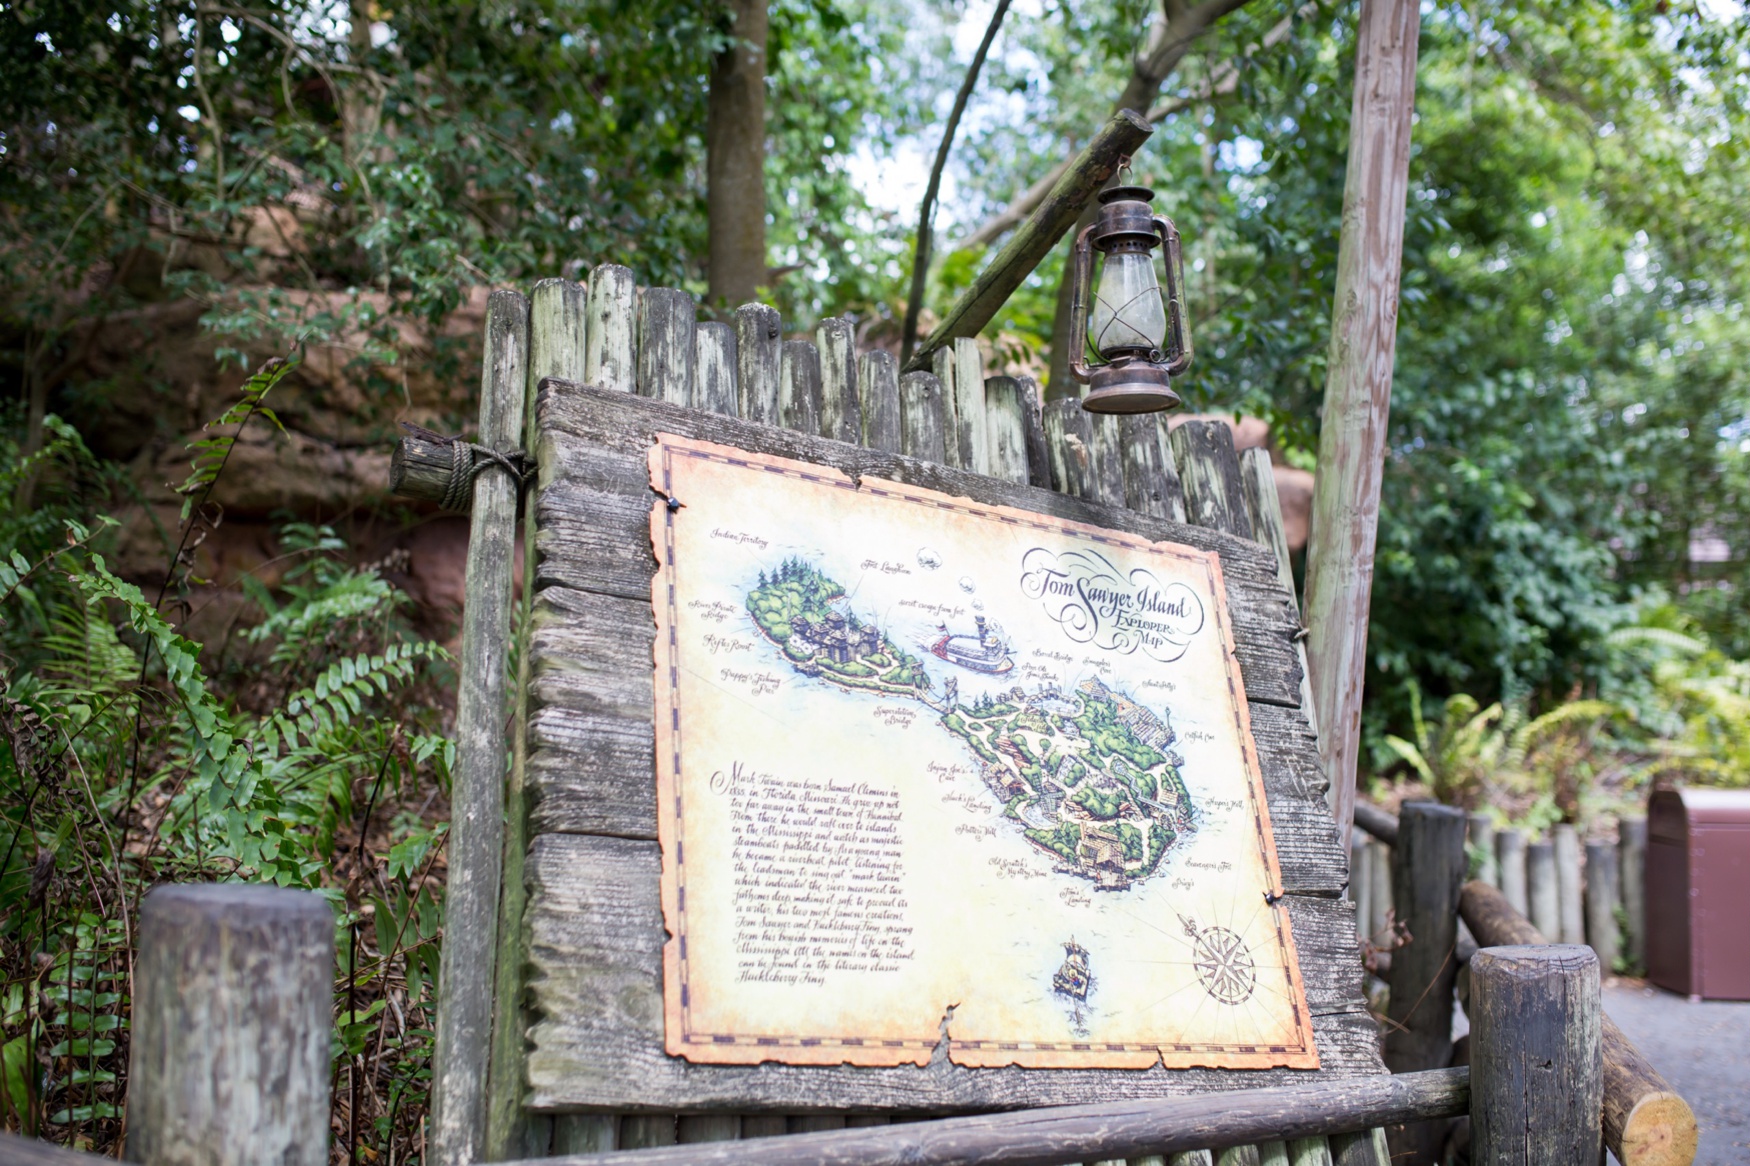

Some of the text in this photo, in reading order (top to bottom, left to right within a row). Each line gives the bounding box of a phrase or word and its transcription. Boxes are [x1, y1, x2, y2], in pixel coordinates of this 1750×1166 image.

[1021, 566, 1075, 600] Tom
[1136, 585, 1191, 618] Island
[710, 760, 755, 795] Mark
[758, 774, 784, 787] Twain
[750, 785, 759, 797] in
